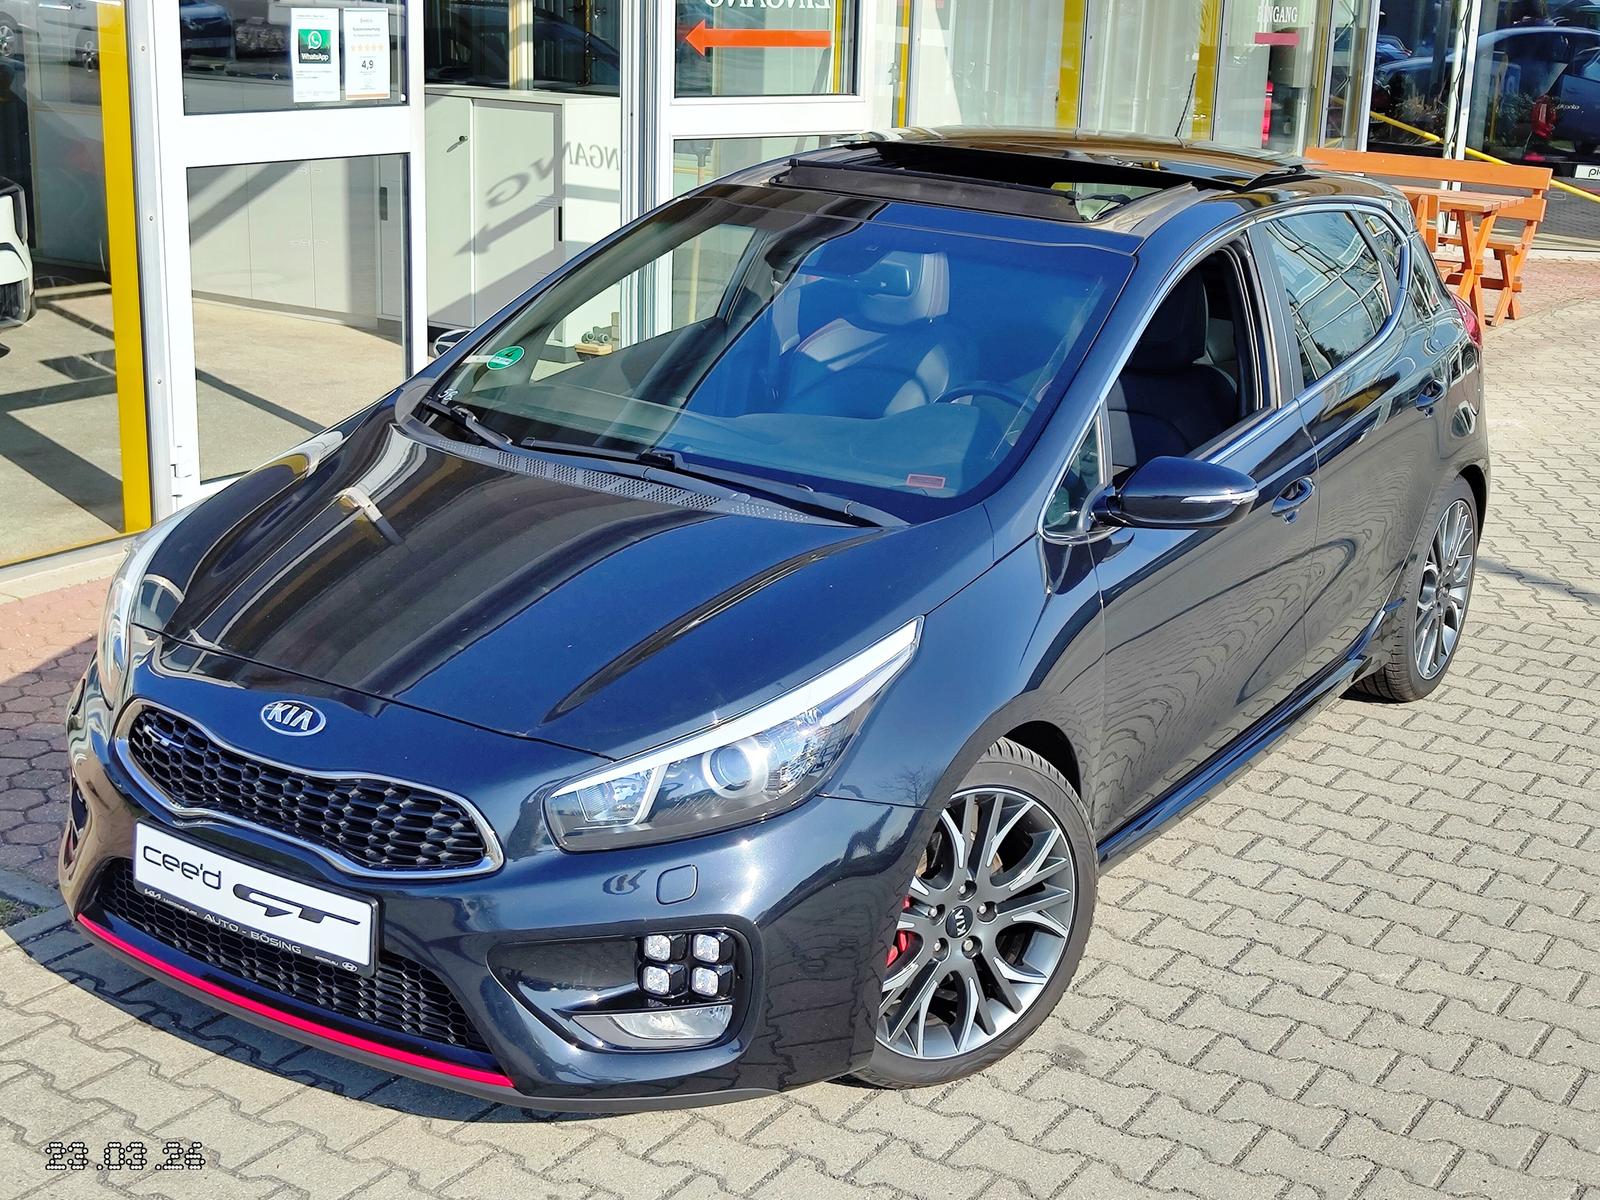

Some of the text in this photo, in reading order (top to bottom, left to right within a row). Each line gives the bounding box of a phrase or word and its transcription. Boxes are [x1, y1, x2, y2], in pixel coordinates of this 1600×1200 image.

[1258, 6, 1298, 23] EINGANG
[301, 53, 329, 62] WhatsApp
[361, 60, 374, 70] 4,9
[267, 703, 314, 731] KIA
[954, 908, 967, 935] KIA
[203, 913, 239, 932] AUTO
[250, 930, 302, 955] BÖSING
